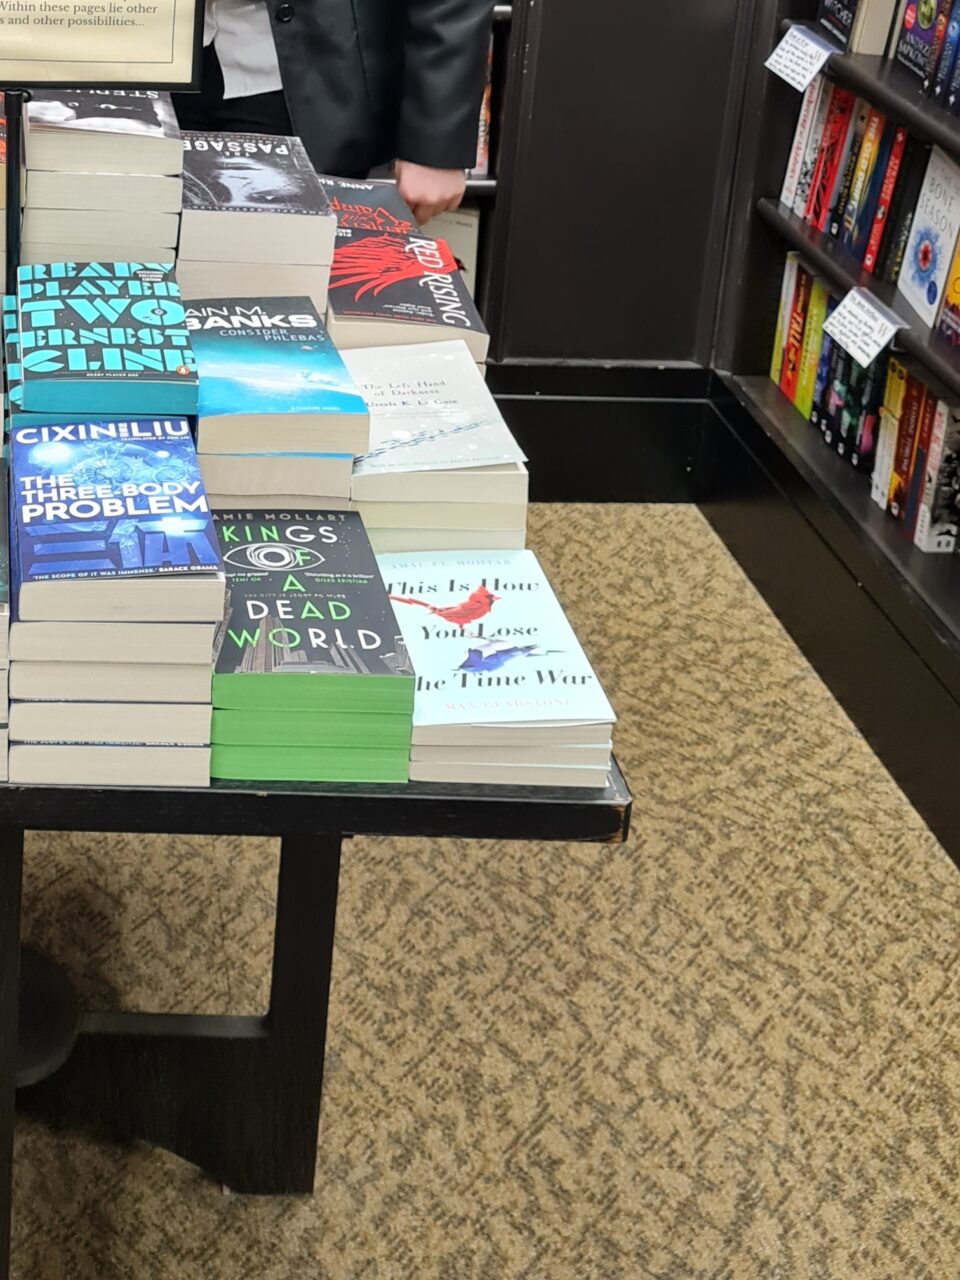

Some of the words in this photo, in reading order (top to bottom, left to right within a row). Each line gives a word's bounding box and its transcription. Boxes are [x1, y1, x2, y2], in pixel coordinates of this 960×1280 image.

[40, 1, 69, 13] these
[73, 4, 105, 16] pages
[109, 3, 123, 13] lie
[126, 3, 157, 14] other
[8, 15, 29, 25] and
[33, 15, 63, 25] other
[67, 15, 144, 28] possibilities...
[182, 140, 289, 155] PASSAGE
[404, 236, 444, 275] RED
[21, 280, 180, 299] PLAYER
[419, 270, 471, 327] RISING
[20, 298, 187, 327] TWO
[21, 327, 190, 347] ERNEST
[219, 328, 288, 337] CONSIDER
[265, 334, 325, 342] PHLEBAS
[22, 348, 197, 372] CLINE
[15, 423, 116, 443] CIXIN
[132, 420, 189, 437] LIU
[20, 474, 74, 489] THE
[21, 481, 201, 504] THREE-BODY
[22, 495, 208, 523] PROBLEM
[265, 513, 346, 521] MOLLART
[222, 525, 338, 543] KINGS
[283, 574, 306, 592] A
[387, 581, 437, 595] This
[449, 579, 470, 592] Is
[481, 579, 539, 592] How
[246, 600, 351, 620] DEAD
[227, 628, 381, 650] WORLD
[421, 626, 465, 640] You
[477, 624, 538, 638] Lose
[417, 676, 446, 691] he
[452, 673, 526, 689] Time
[536, 670, 592, 685] War
